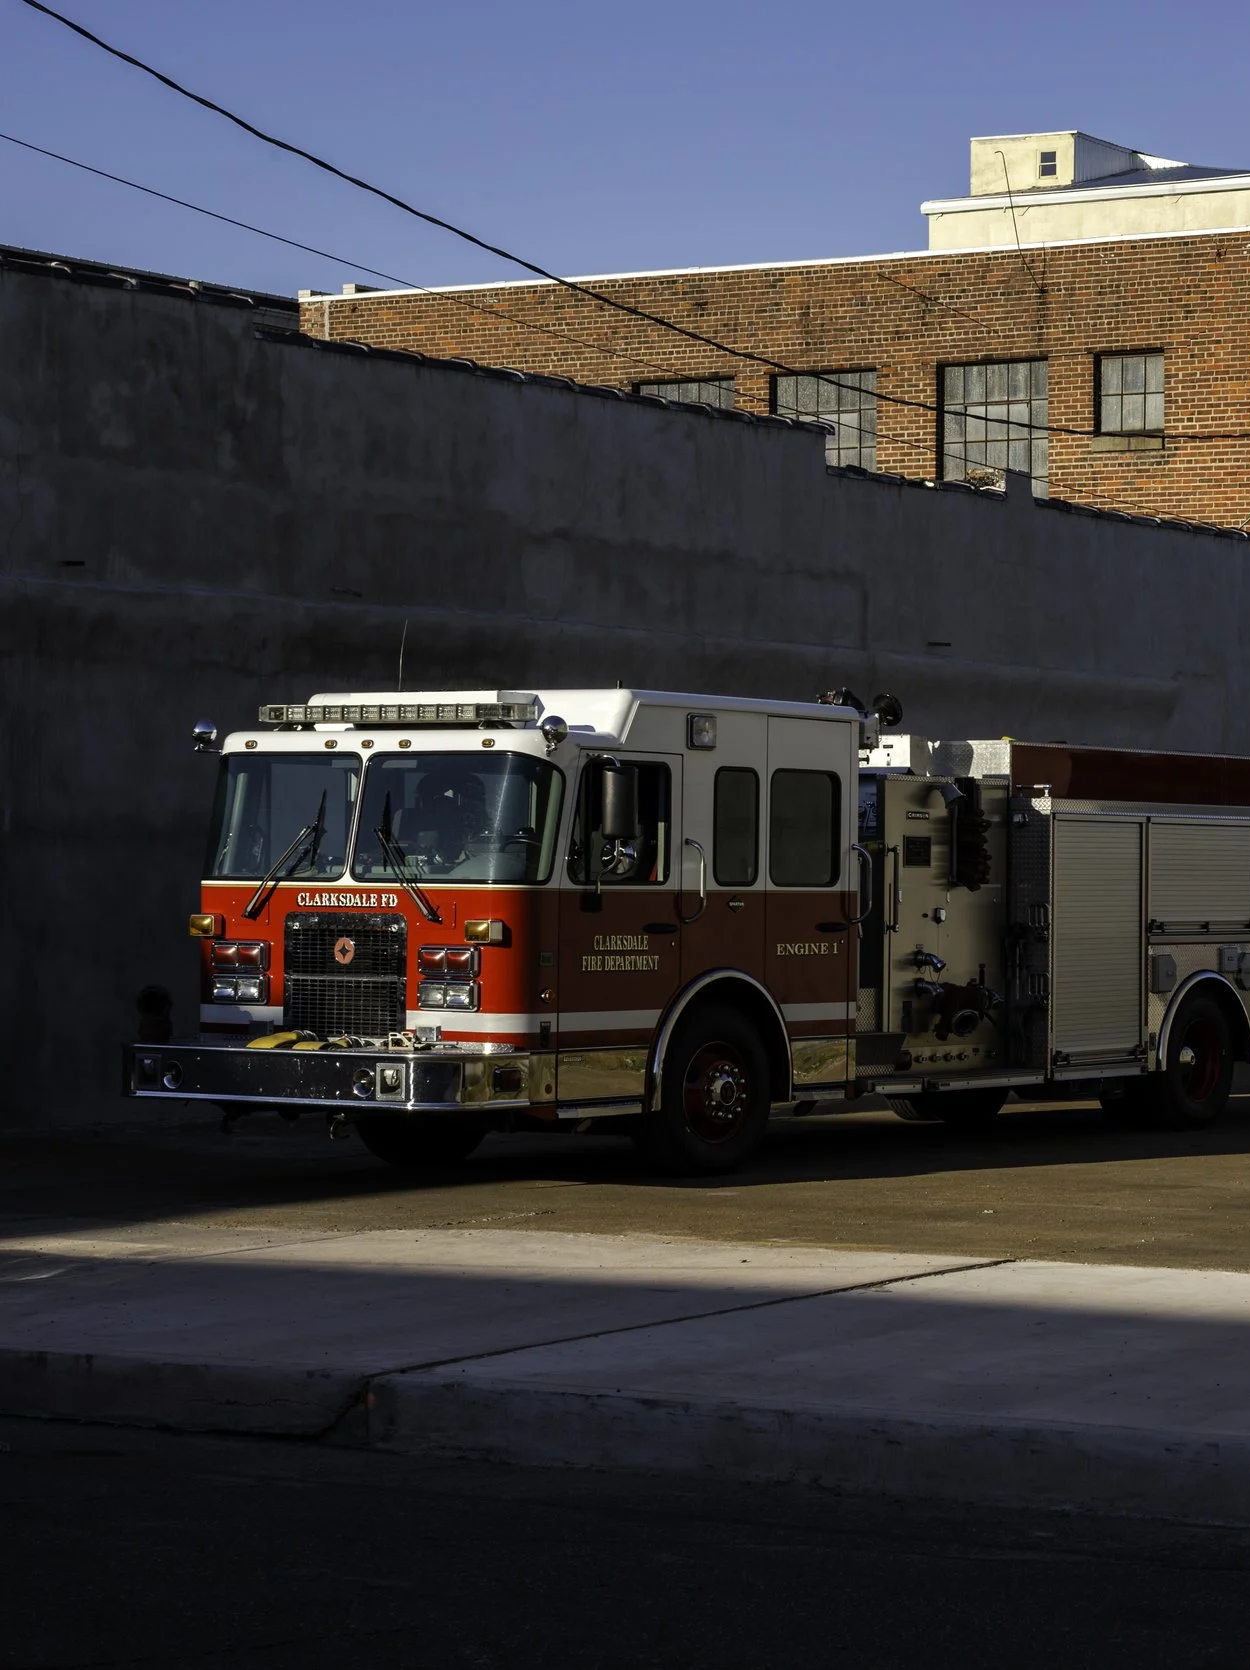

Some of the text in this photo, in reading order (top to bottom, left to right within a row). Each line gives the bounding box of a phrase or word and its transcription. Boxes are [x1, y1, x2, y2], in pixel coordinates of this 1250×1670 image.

[297, 892, 398, 907] CLARKSDALE FD
[593, 935, 649, 951] CLARKSDALE
[776, 942, 839, 956] ENGINE 1
[581, 955, 660, 971] FIRE DEPARTMENT
